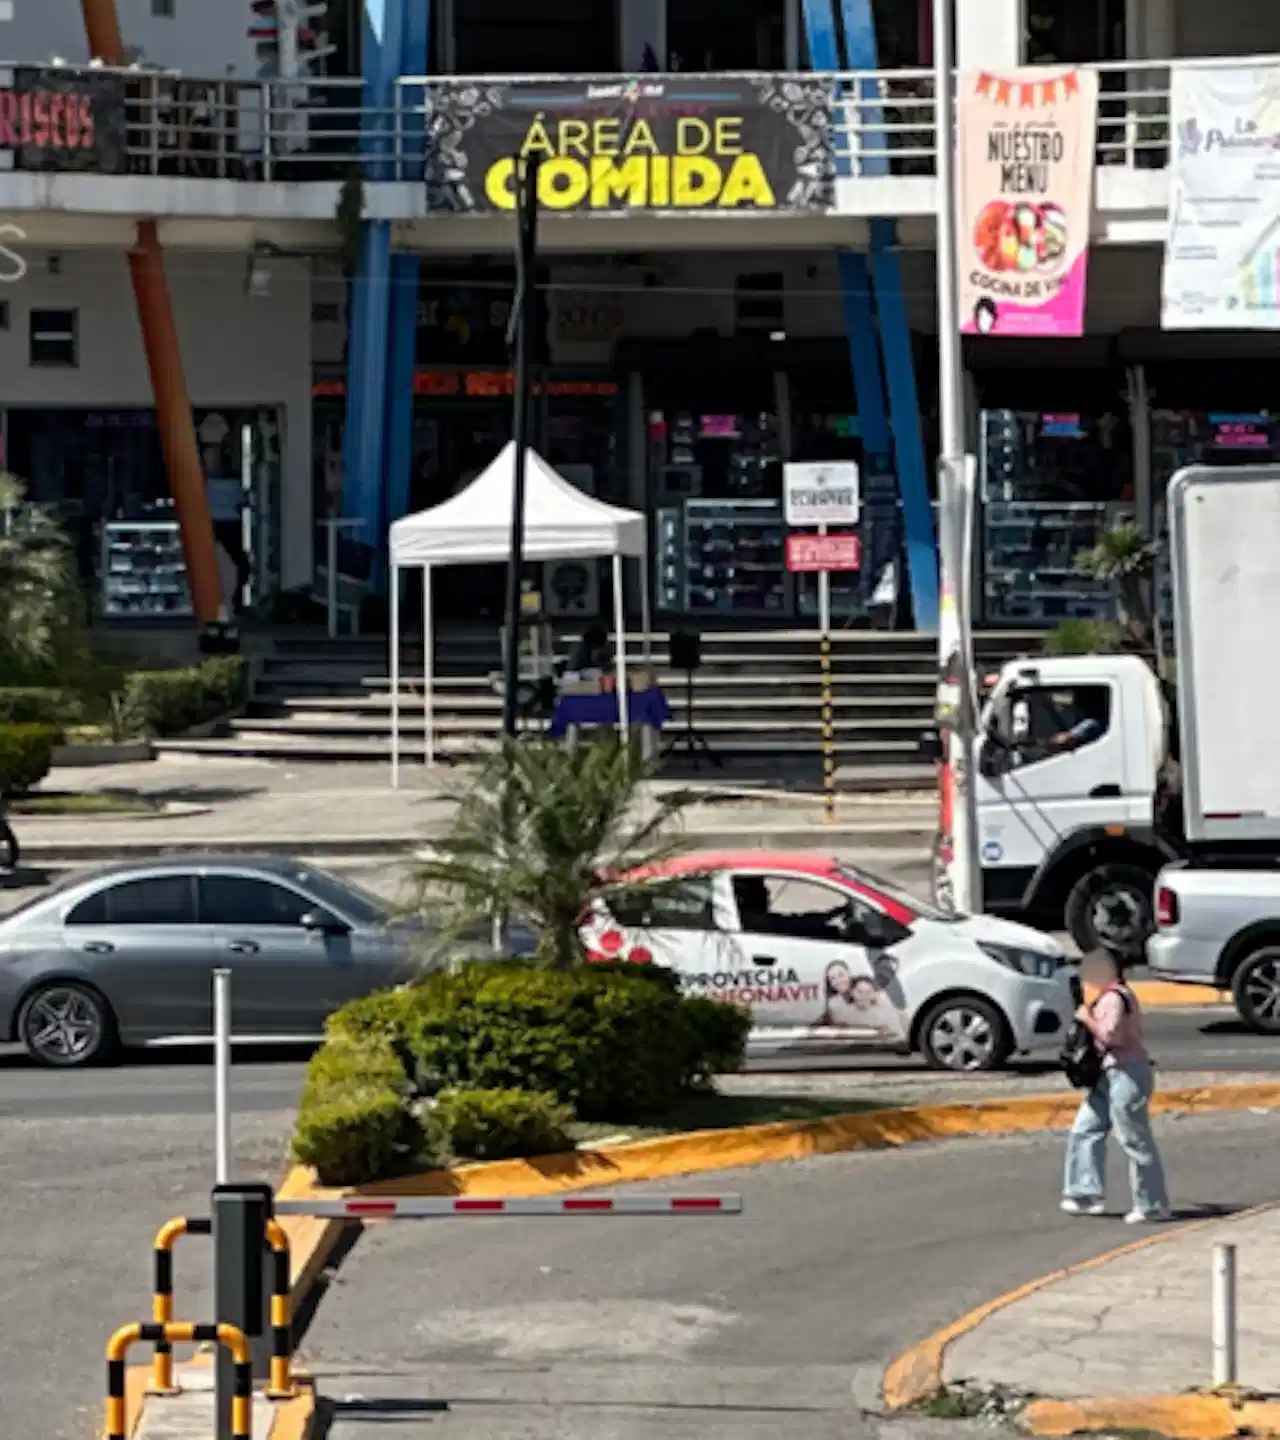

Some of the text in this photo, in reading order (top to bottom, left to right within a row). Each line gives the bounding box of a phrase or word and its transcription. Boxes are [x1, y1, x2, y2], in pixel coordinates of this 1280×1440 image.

[520, 110, 745, 157] ÁREA DE
[484, 152, 776, 211] COMIDA
[676, 967, 801, 988] PROVECHA
